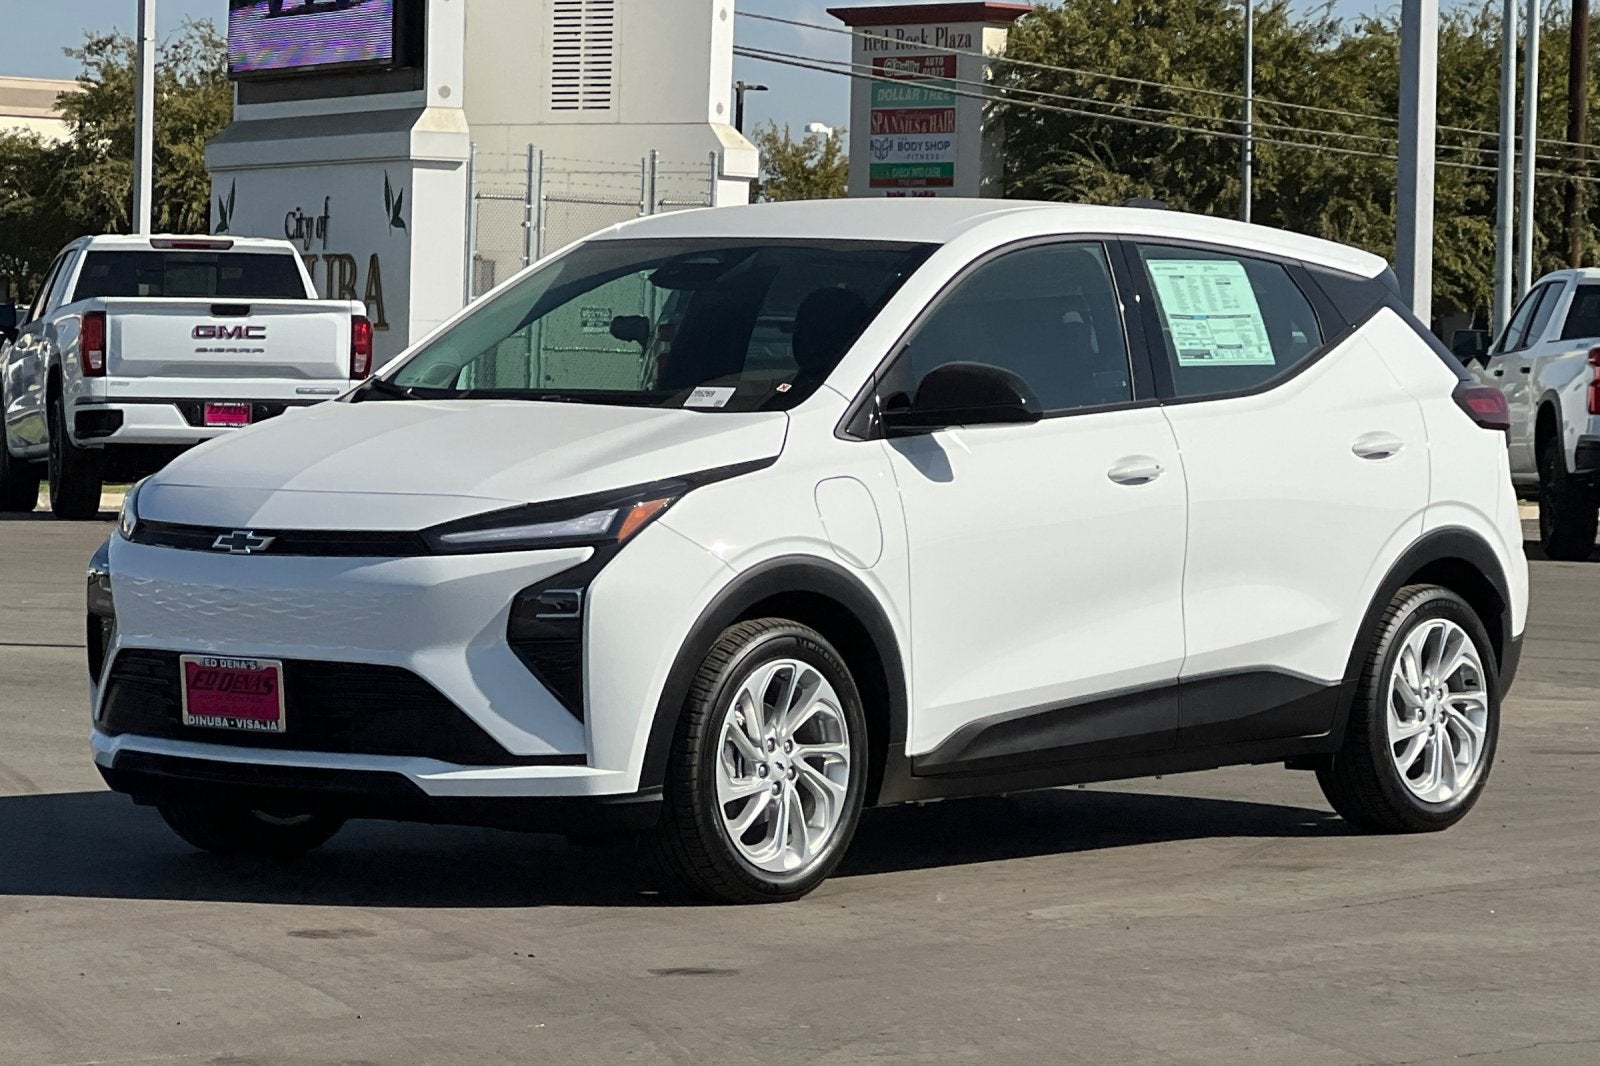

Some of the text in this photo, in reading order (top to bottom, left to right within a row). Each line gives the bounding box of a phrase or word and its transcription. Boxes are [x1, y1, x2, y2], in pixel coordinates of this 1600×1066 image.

[863, 26, 972, 51] Red Rock Plaza
[924, 57, 944, 67] AUTO
[922, 67, 945, 77] PARTS
[877, 87, 921, 101] DOLLAR
[872, 111, 889, 133] SPA
[891, 115, 920, 133] NAILS
[929, 110, 955, 133] HAIR
[897, 140, 951, 152] BODY SHOP
[284, 195, 330, 250] City of
[191, 325, 266, 340] GMC
[204, 658, 257, 670] ED DENA'S
[188, 715, 278, 731] DINUBA VISALIA
